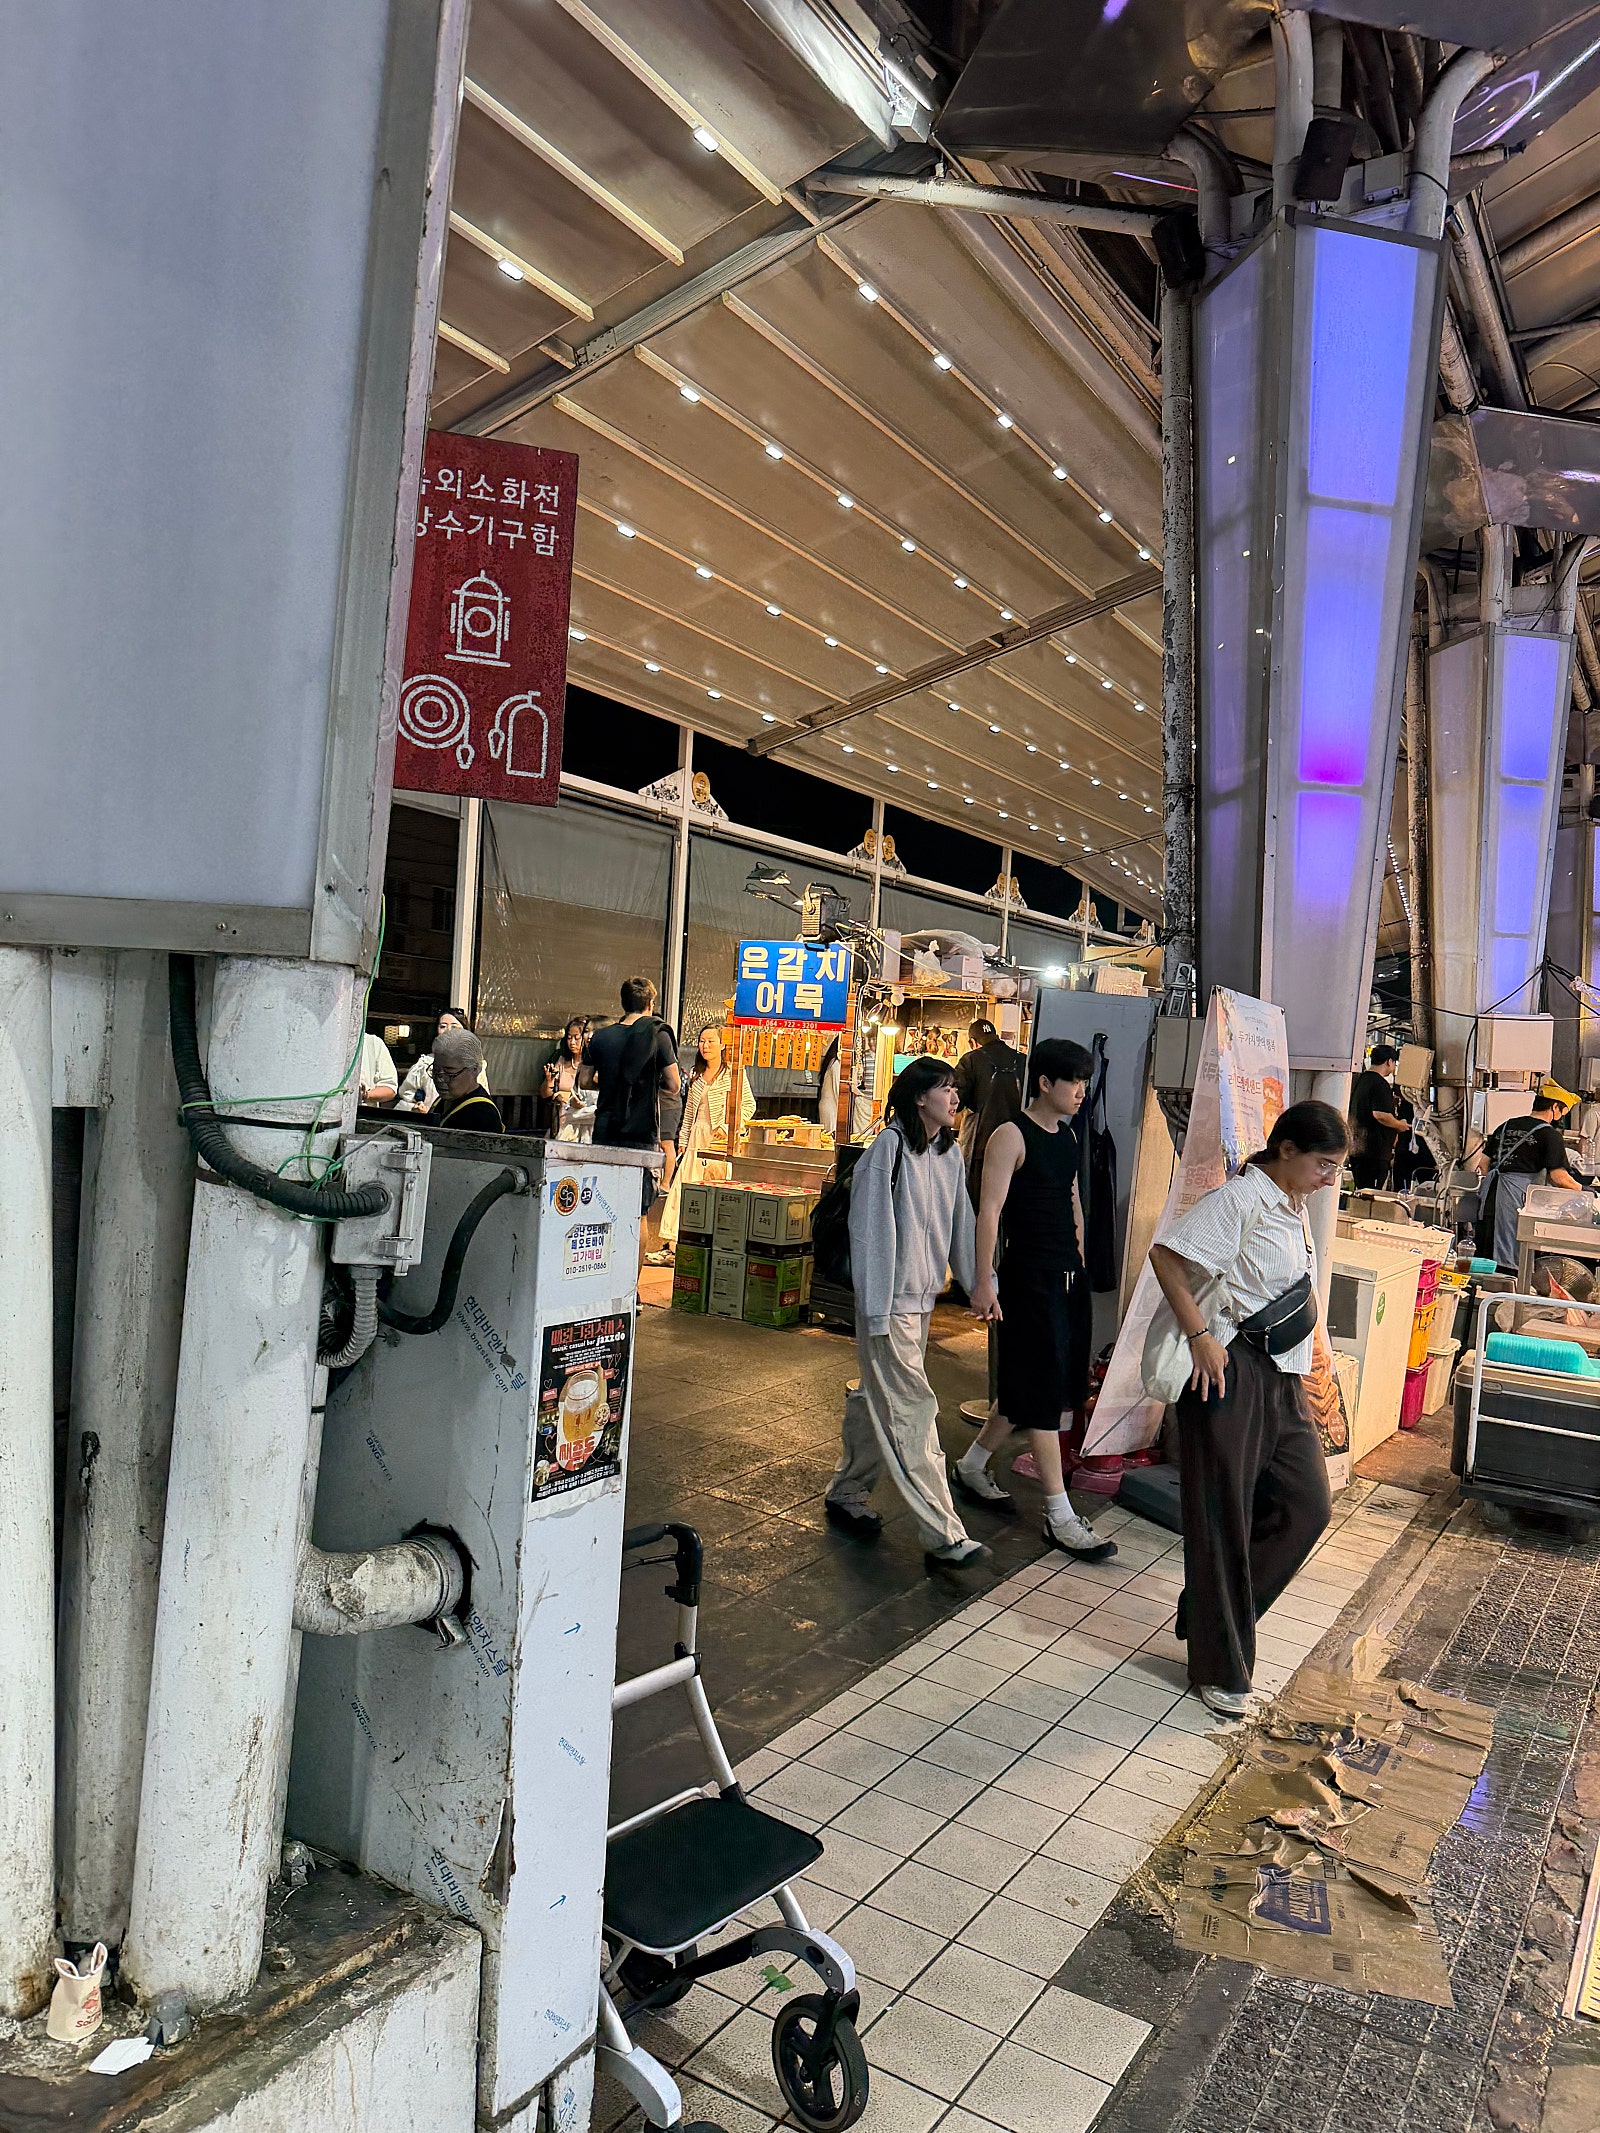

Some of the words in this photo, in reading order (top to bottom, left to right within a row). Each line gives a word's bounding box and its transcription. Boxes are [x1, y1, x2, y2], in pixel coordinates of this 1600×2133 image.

[742, 947, 846, 982] 은갈치
[756, 982, 823, 1018] 어묵
[572, 1249, 603, 1263] 고가매입
[596, 1331, 626, 1346] jazzdo
